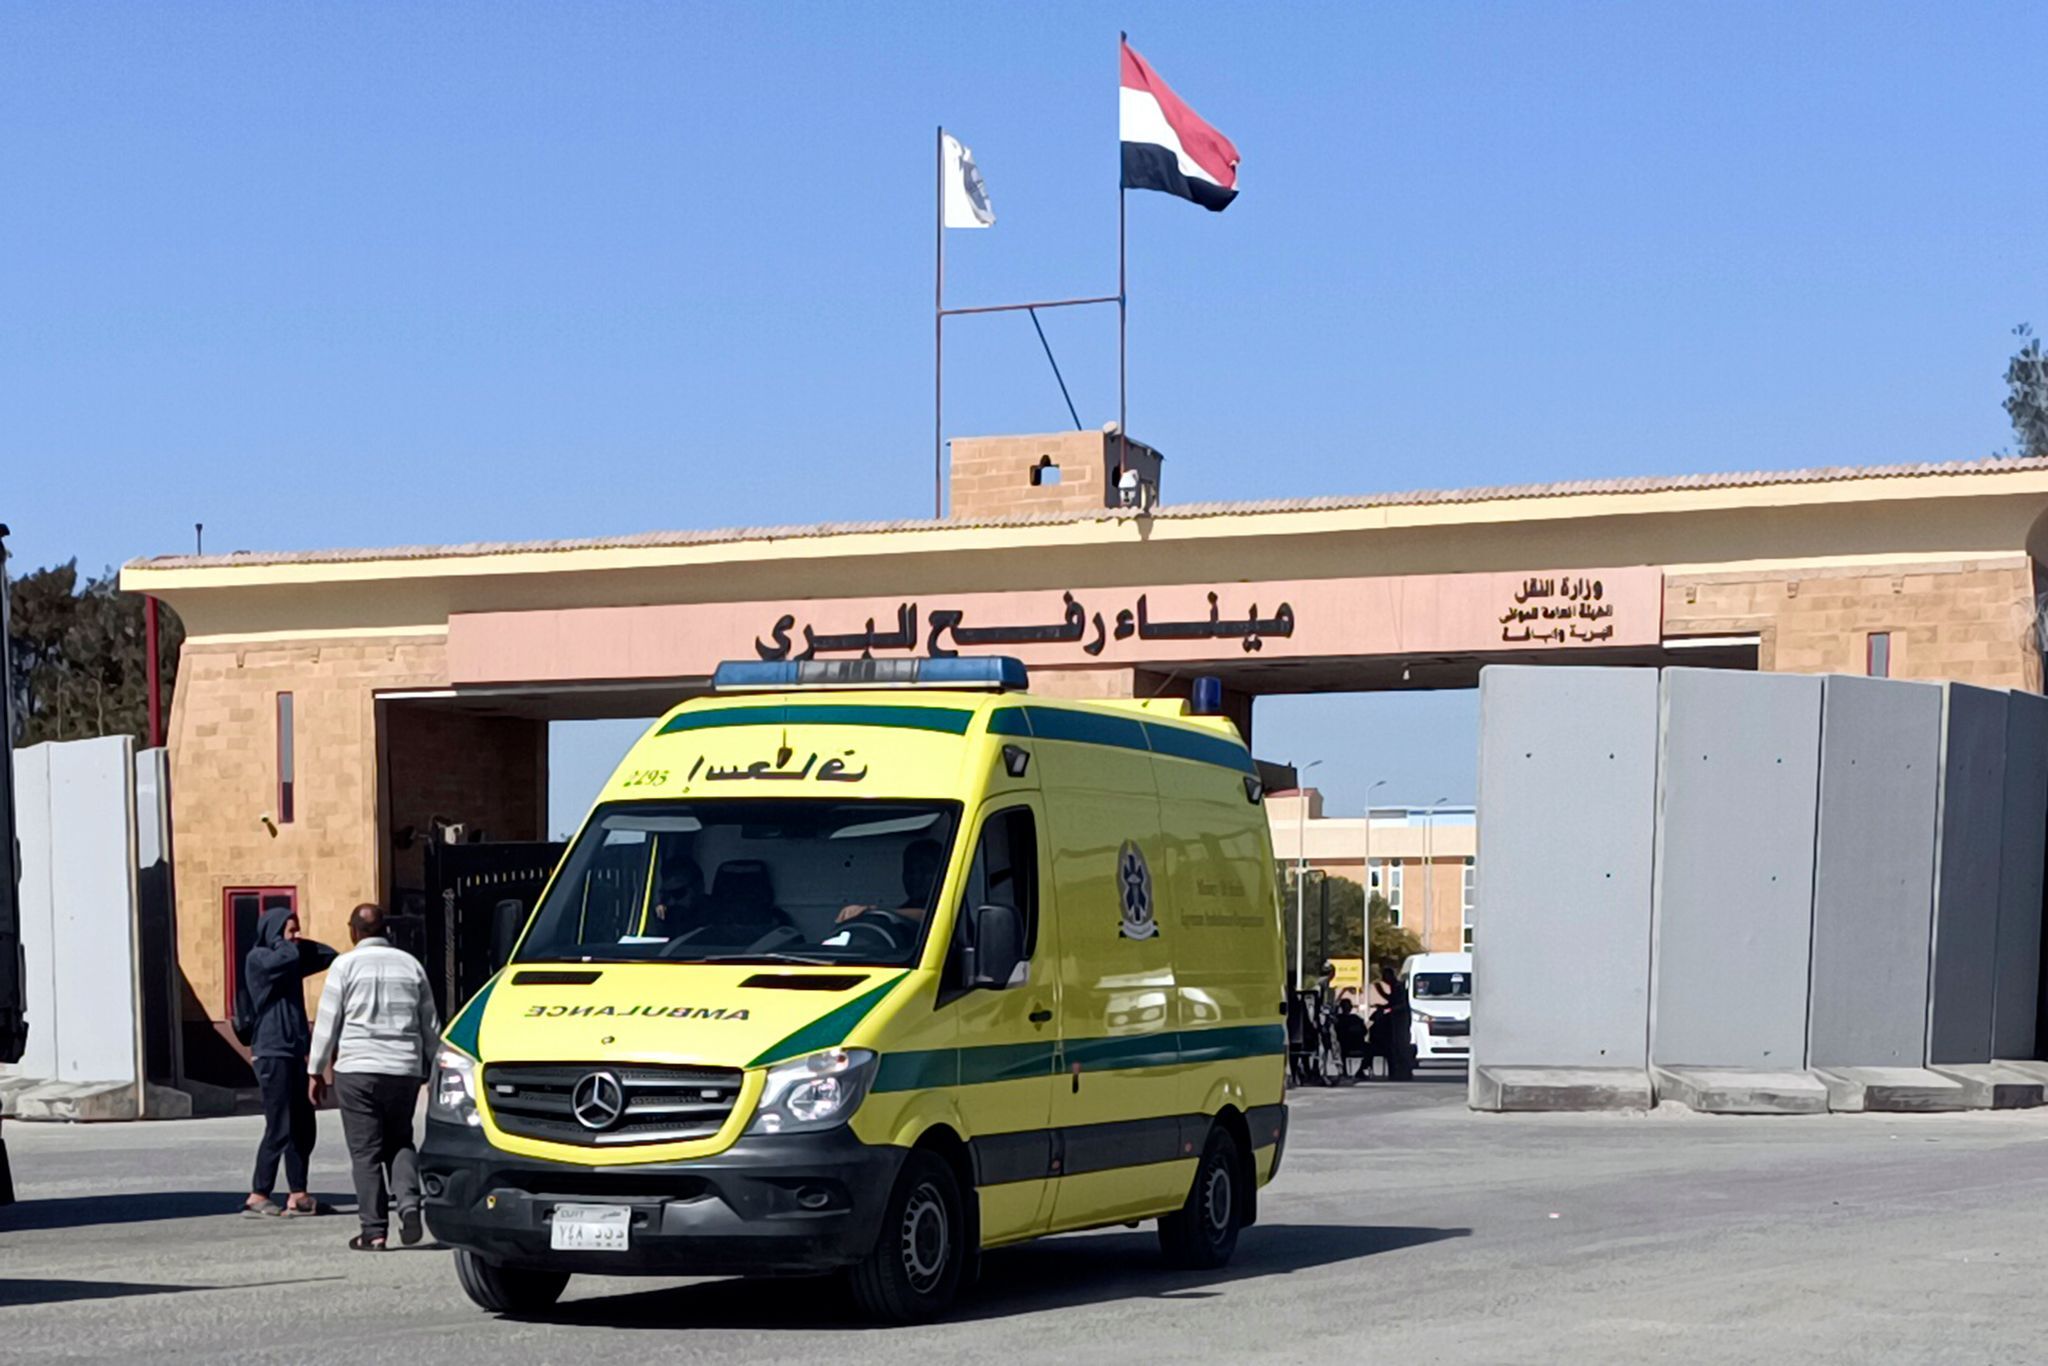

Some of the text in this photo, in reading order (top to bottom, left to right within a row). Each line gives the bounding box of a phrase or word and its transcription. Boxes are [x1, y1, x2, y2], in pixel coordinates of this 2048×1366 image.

[1514, 576, 1603, 604] وزارة النقل
[1541, 605, 1577, 619] العامة
[927, 591, 1106, 657] رفح
[1114, 591, 1295, 653] ميناء
